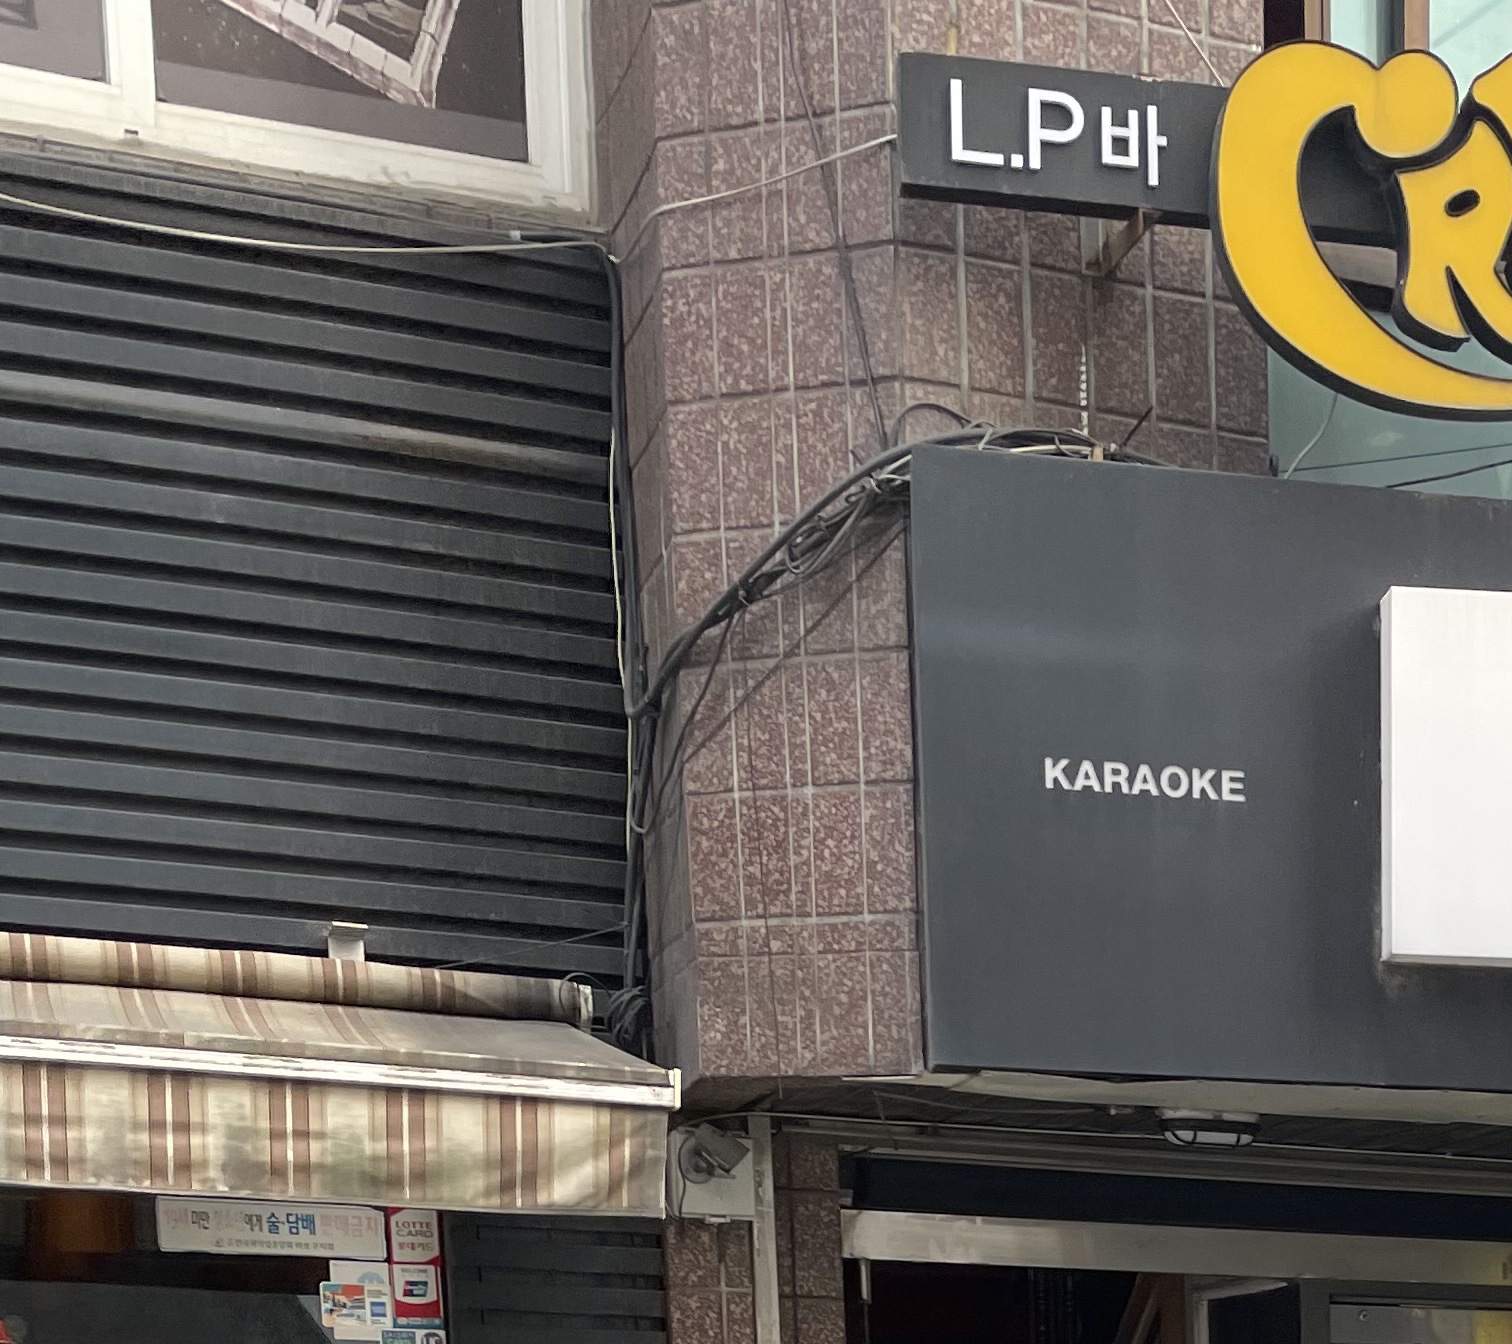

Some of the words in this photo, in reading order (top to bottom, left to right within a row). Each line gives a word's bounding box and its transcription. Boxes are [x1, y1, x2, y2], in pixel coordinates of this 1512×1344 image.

[1044, 756, 1247, 803] KARAOKE
[190, 1210, 210, 1230] 미만
[395, 1220, 432, 1230] LOTTE
[395, 1229, 434, 1239] CARD
